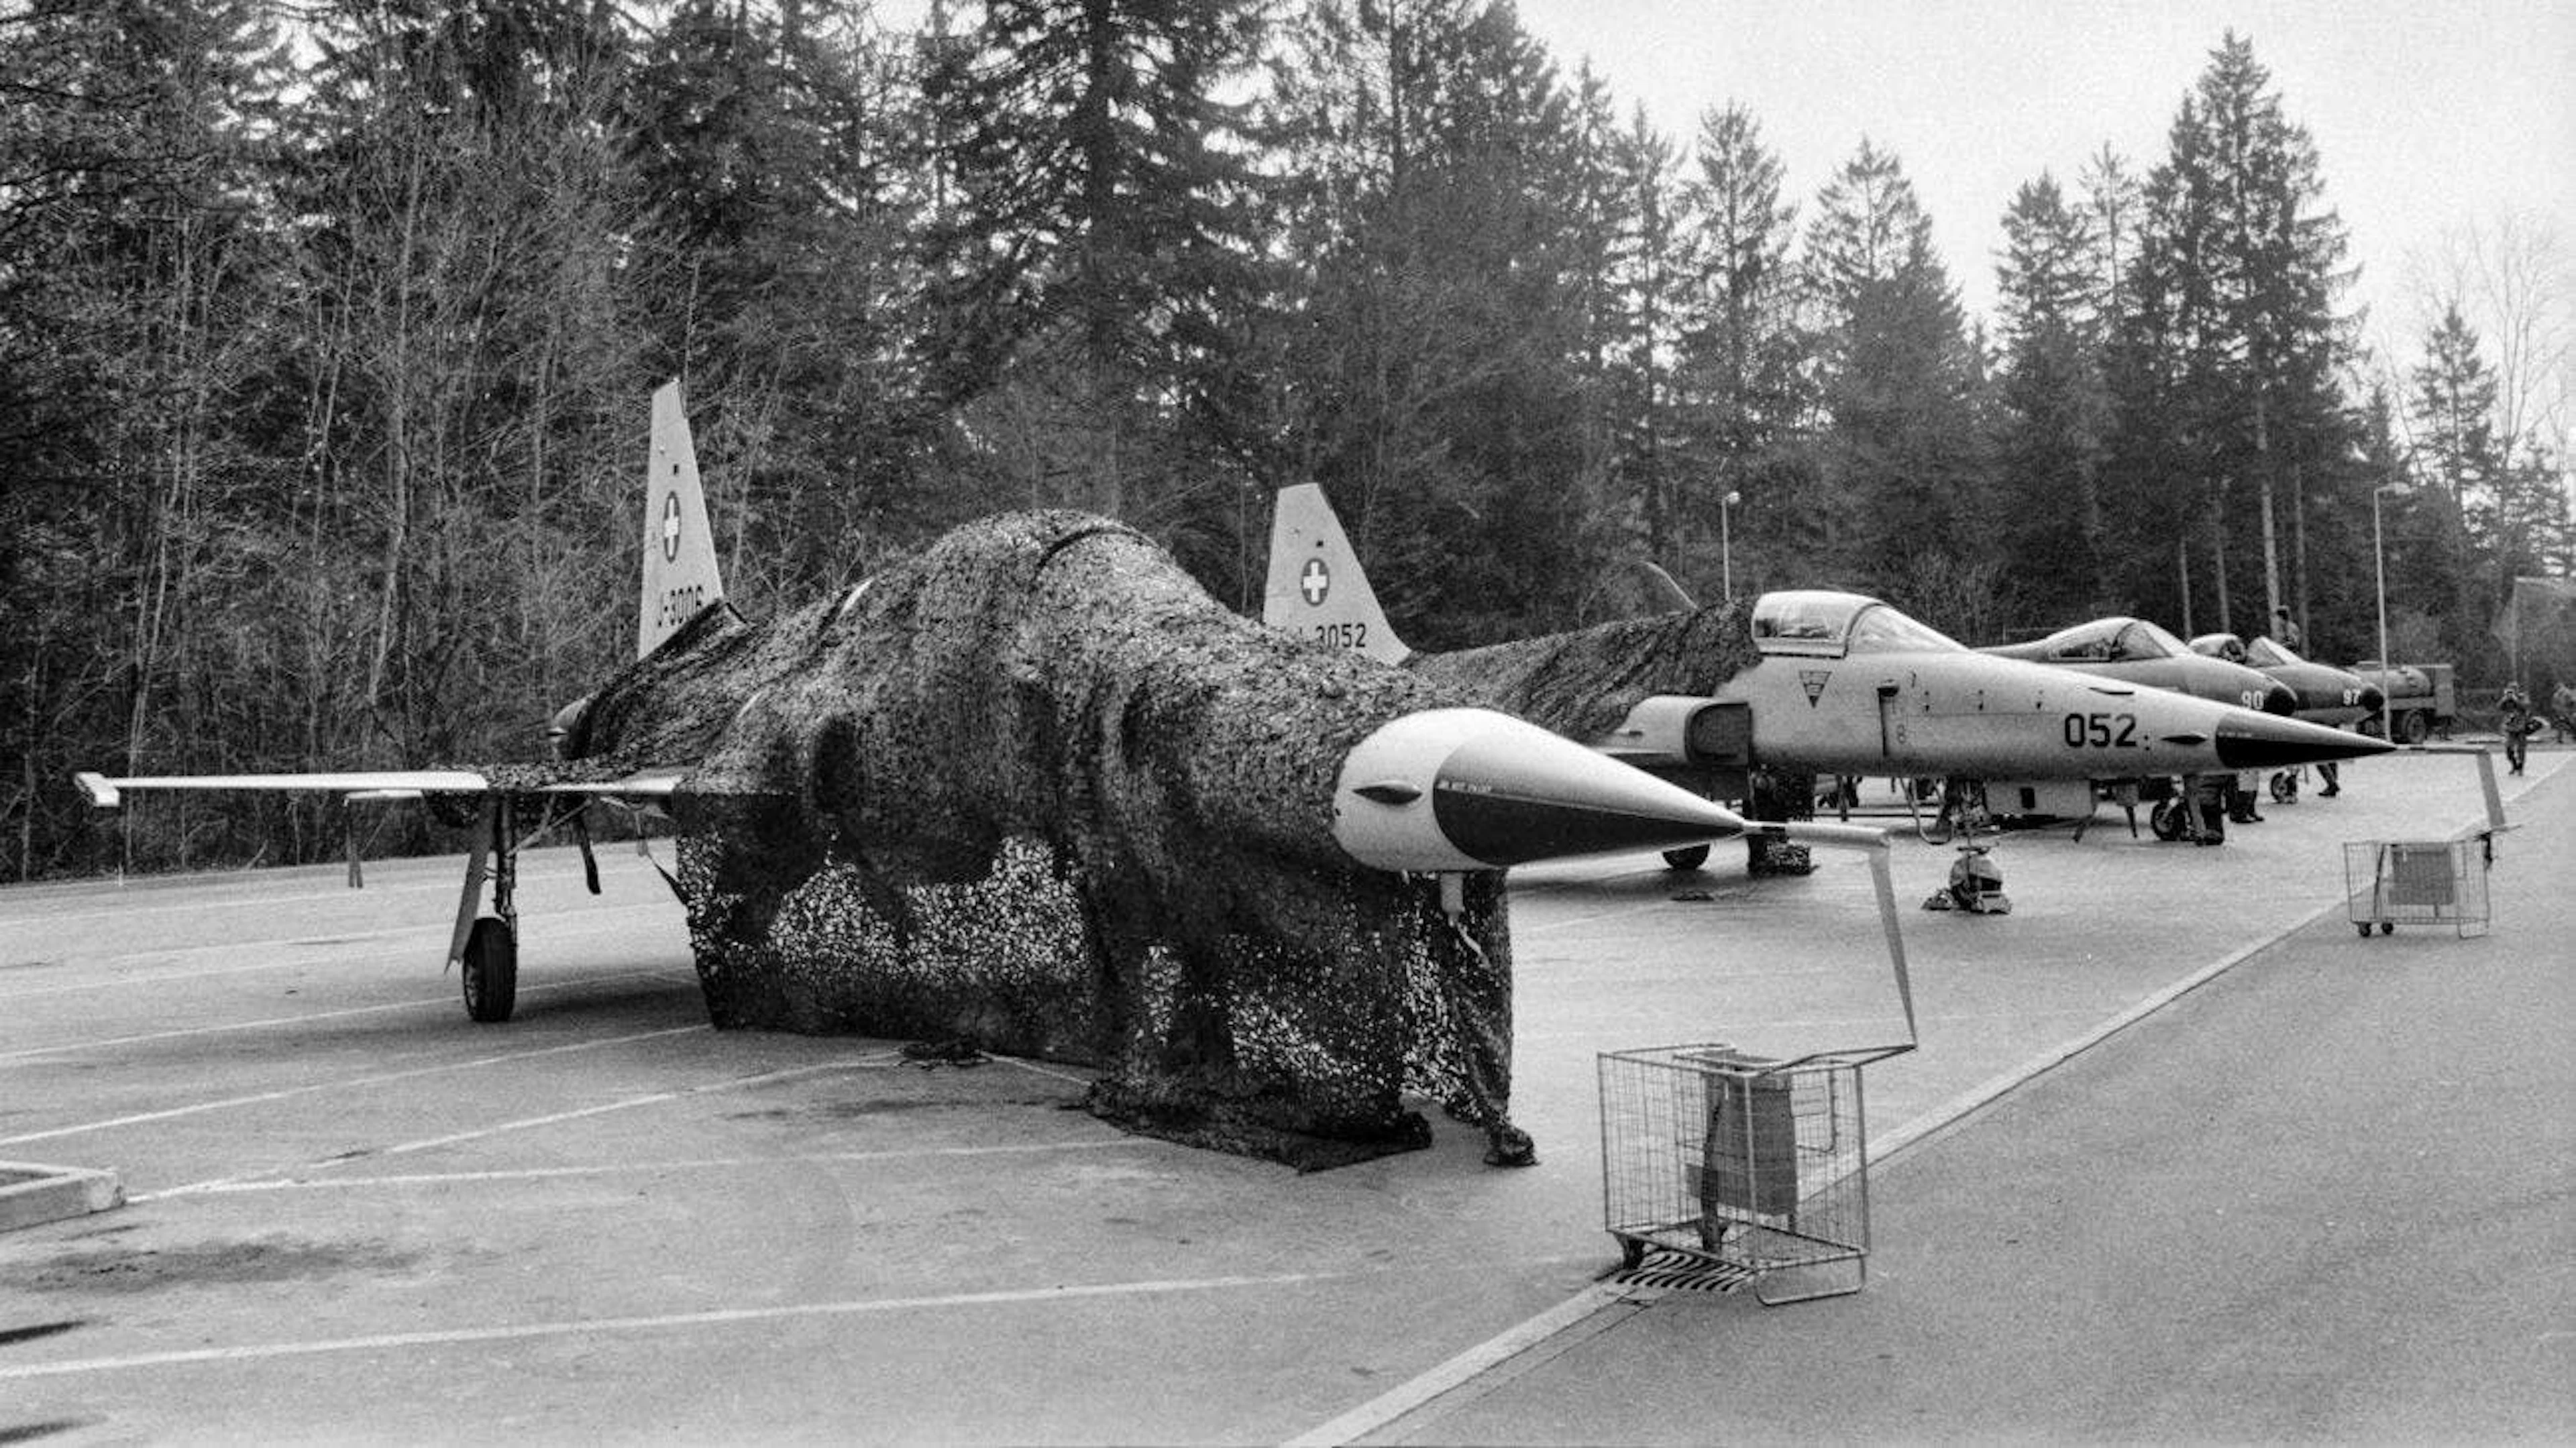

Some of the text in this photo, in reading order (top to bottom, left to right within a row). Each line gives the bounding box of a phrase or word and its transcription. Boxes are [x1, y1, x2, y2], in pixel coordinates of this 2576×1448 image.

[2241, 690, 2264, 710] 90
[2343, 688, 2361, 706] 97
[2065, 713, 2137, 746] 052
